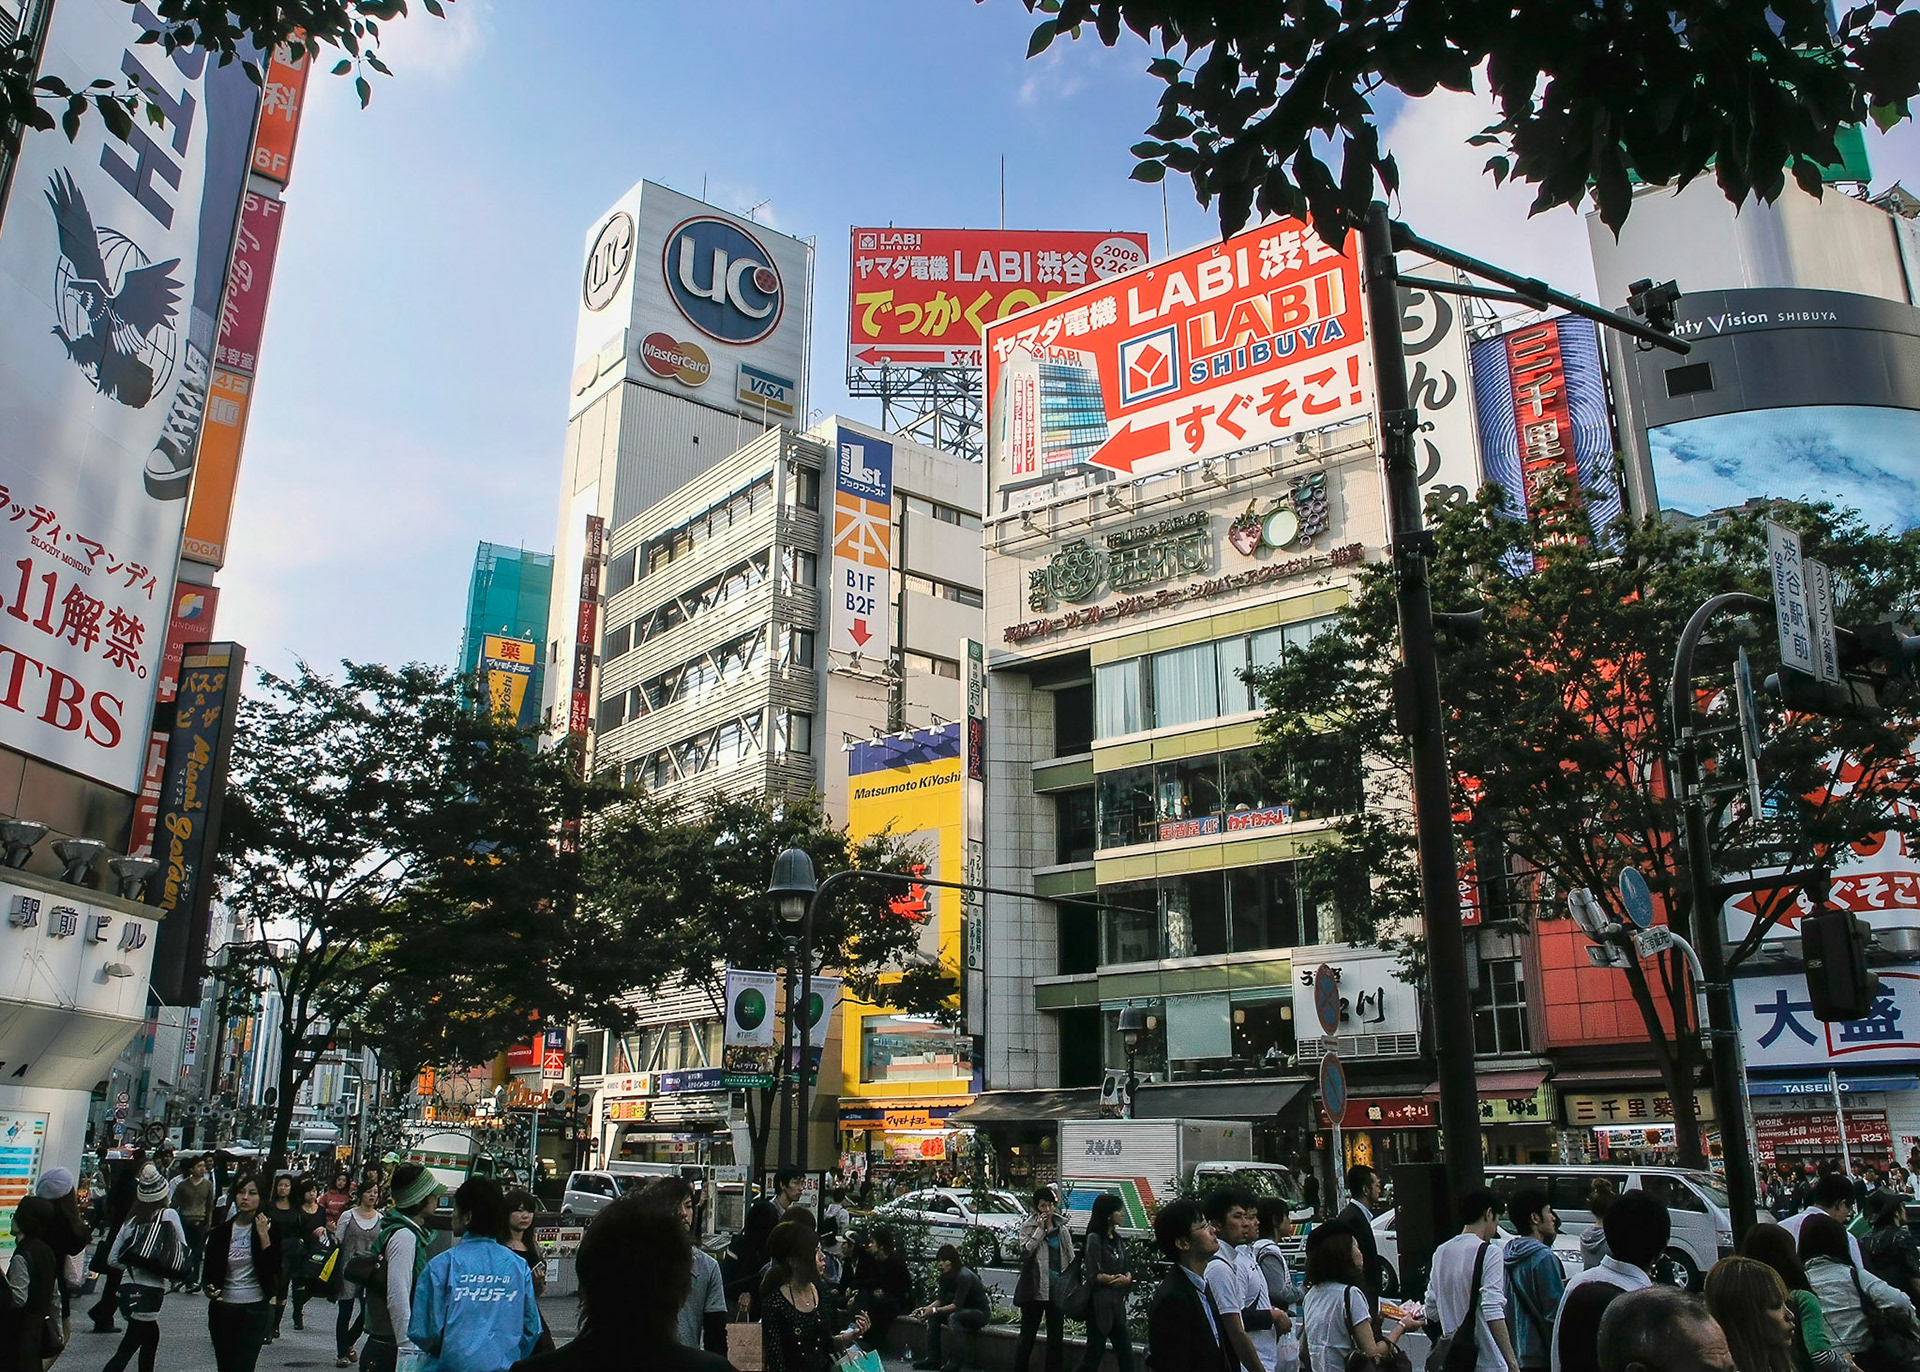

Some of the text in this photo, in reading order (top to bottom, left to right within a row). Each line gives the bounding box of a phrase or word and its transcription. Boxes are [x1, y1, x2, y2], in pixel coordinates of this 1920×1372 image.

[255, 147, 287, 172] 6F
[880, 233, 922, 245] LABI
[1102, 245, 1139, 260] 2008
[856, 250, 1088, 285] ヤマダ電機 LABI 渋谷
[992, 295, 1119, 365] ヤマダ電機
[1127, 248, 1250, 327] LABI
[1188, 267, 1347, 363] LABI
[1707, 310, 1768, 334] Vision
[1777, 310, 1838, 323] SHIBUYA
[643, 341, 709, 375] MasterCard
[1048, 347, 1081, 362] LABI
[1190, 317, 1346, 385] SHIBUYA
[215, 373, 246, 391] 4F
[749, 377, 785, 401] VISA
[1176, 354, 1363, 453] すぐそこ!
[840, 445, 851, 473] BOOK
[840, 475, 887, 497] ブックファースト
[833, 497, 891, 566] 本
[30, 535, 93, 577] BLOODY MONDAY
[183, 539, 219, 557] YOGA
[846, 568, 875, 593] B1F
[845, 592, 875, 616] B2F
[1782, 537, 1809, 661] 渋谷駅前
[501, 641, 521, 660] 薬
[181, 671, 226, 693] パスタ
[176, 706, 222, 728] ピザ
[853, 779, 918, 801] Matsumoto
[1159, 821, 1200, 841] 居酒屋
[12, 895, 147, 953] 駅前ビル
[1783, 1083, 1849, 1093] TAISEIO
[886, 1114, 927, 1127] マツモトキヨシ
[1822, 1125, 1851, 1133] Peper
[1861, 1133, 1883, 1142] R25
[460, 1274, 511, 1284] コンタクトの
[454, 1287, 518, 1302] アイシティ
